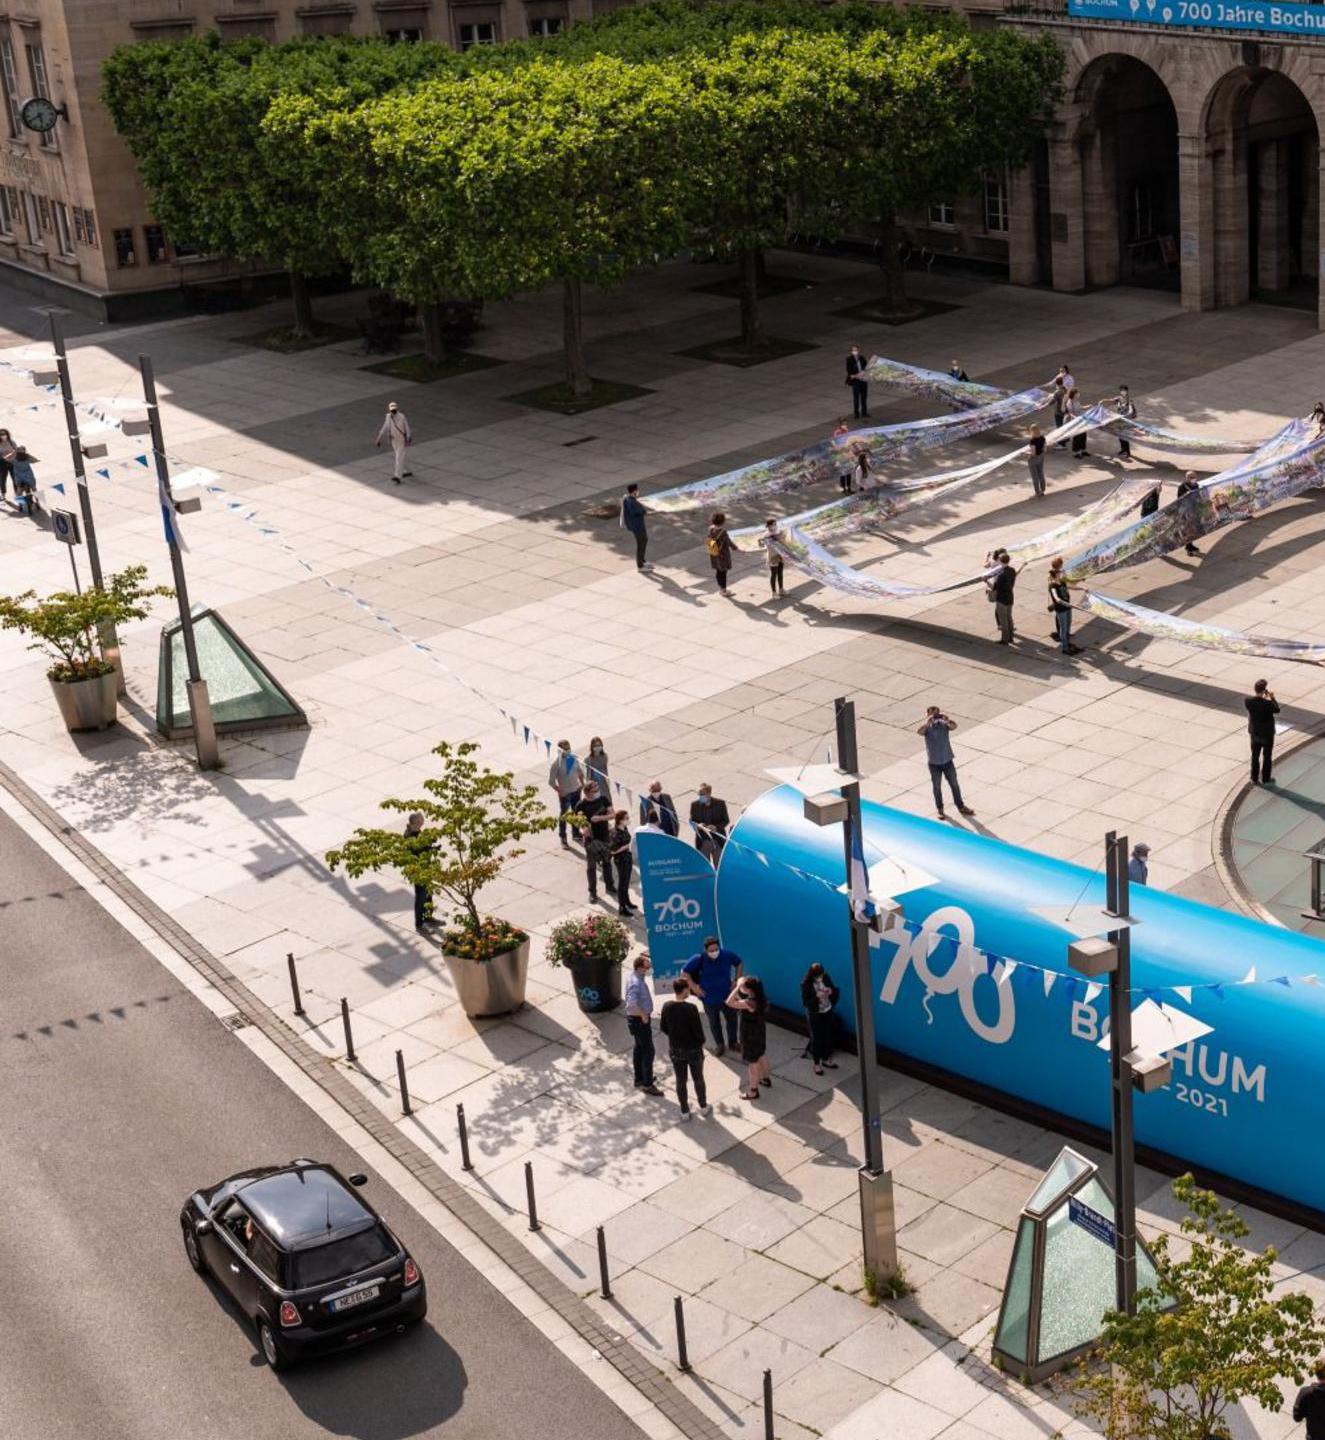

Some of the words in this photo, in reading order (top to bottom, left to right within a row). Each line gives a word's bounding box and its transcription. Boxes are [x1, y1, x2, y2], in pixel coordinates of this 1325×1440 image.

[1178, 2, 1212, 20] 700
[1217, 4, 1265, 23] Jahre
[653, 893, 701, 922] 700
[655, 920, 703, 933] BOCHUM
[868, 905, 1016, 1044] 700
[1071, 1000, 1267, 1103] BHUM
[1175, 1082, 1229, 1117] 2021
